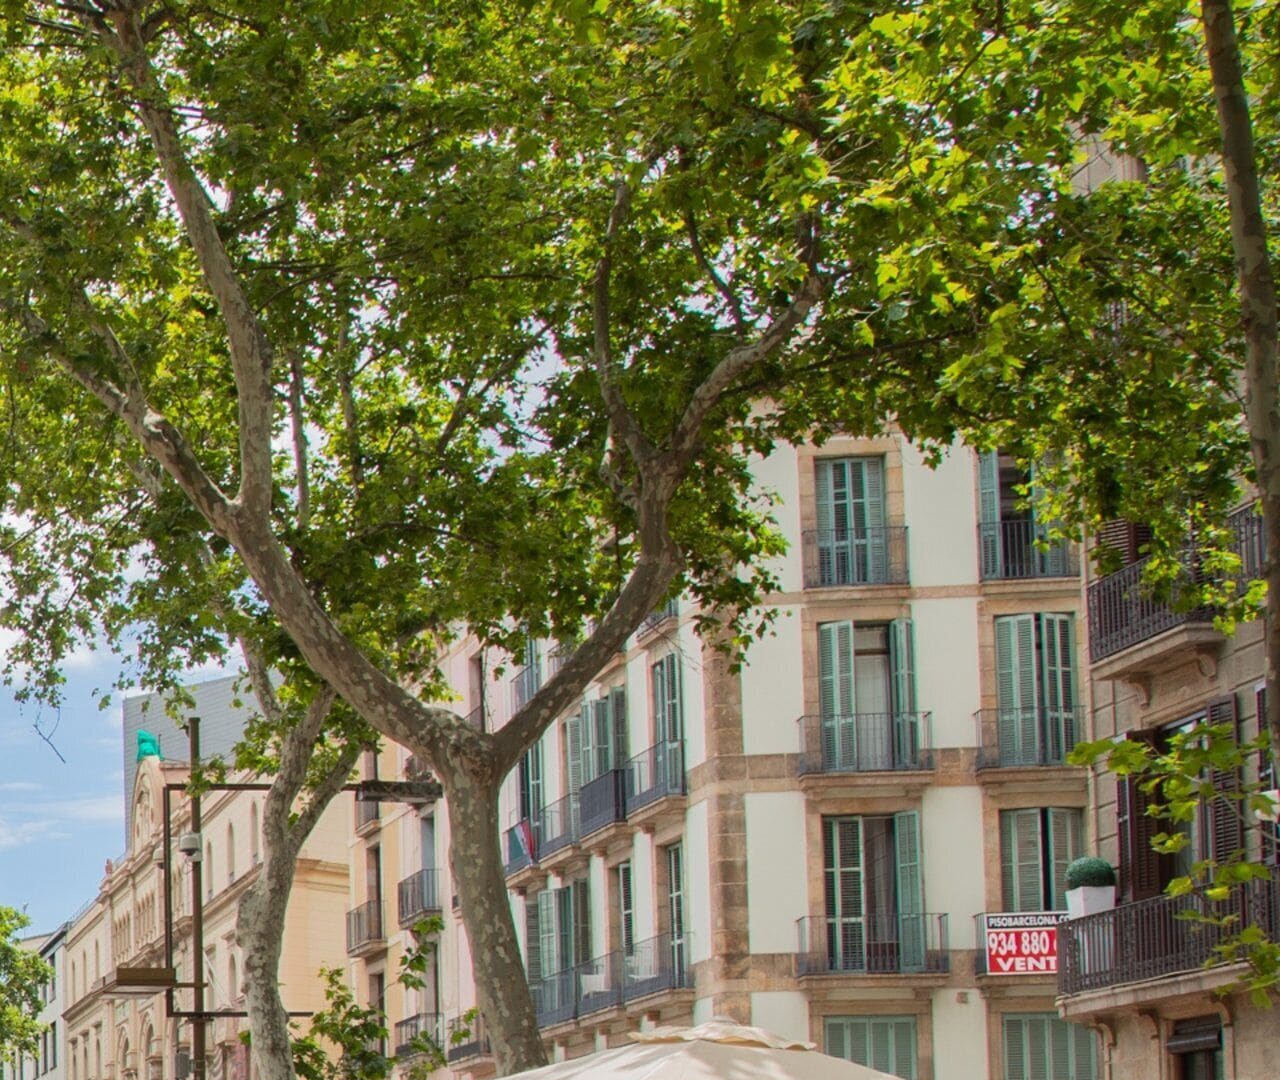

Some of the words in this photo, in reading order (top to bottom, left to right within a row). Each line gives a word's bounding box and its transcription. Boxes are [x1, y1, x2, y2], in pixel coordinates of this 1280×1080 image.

[988, 931, 1017, 956] 934
[1021, 931, 1050, 955] 880
[996, 956, 1057, 971] VENT
